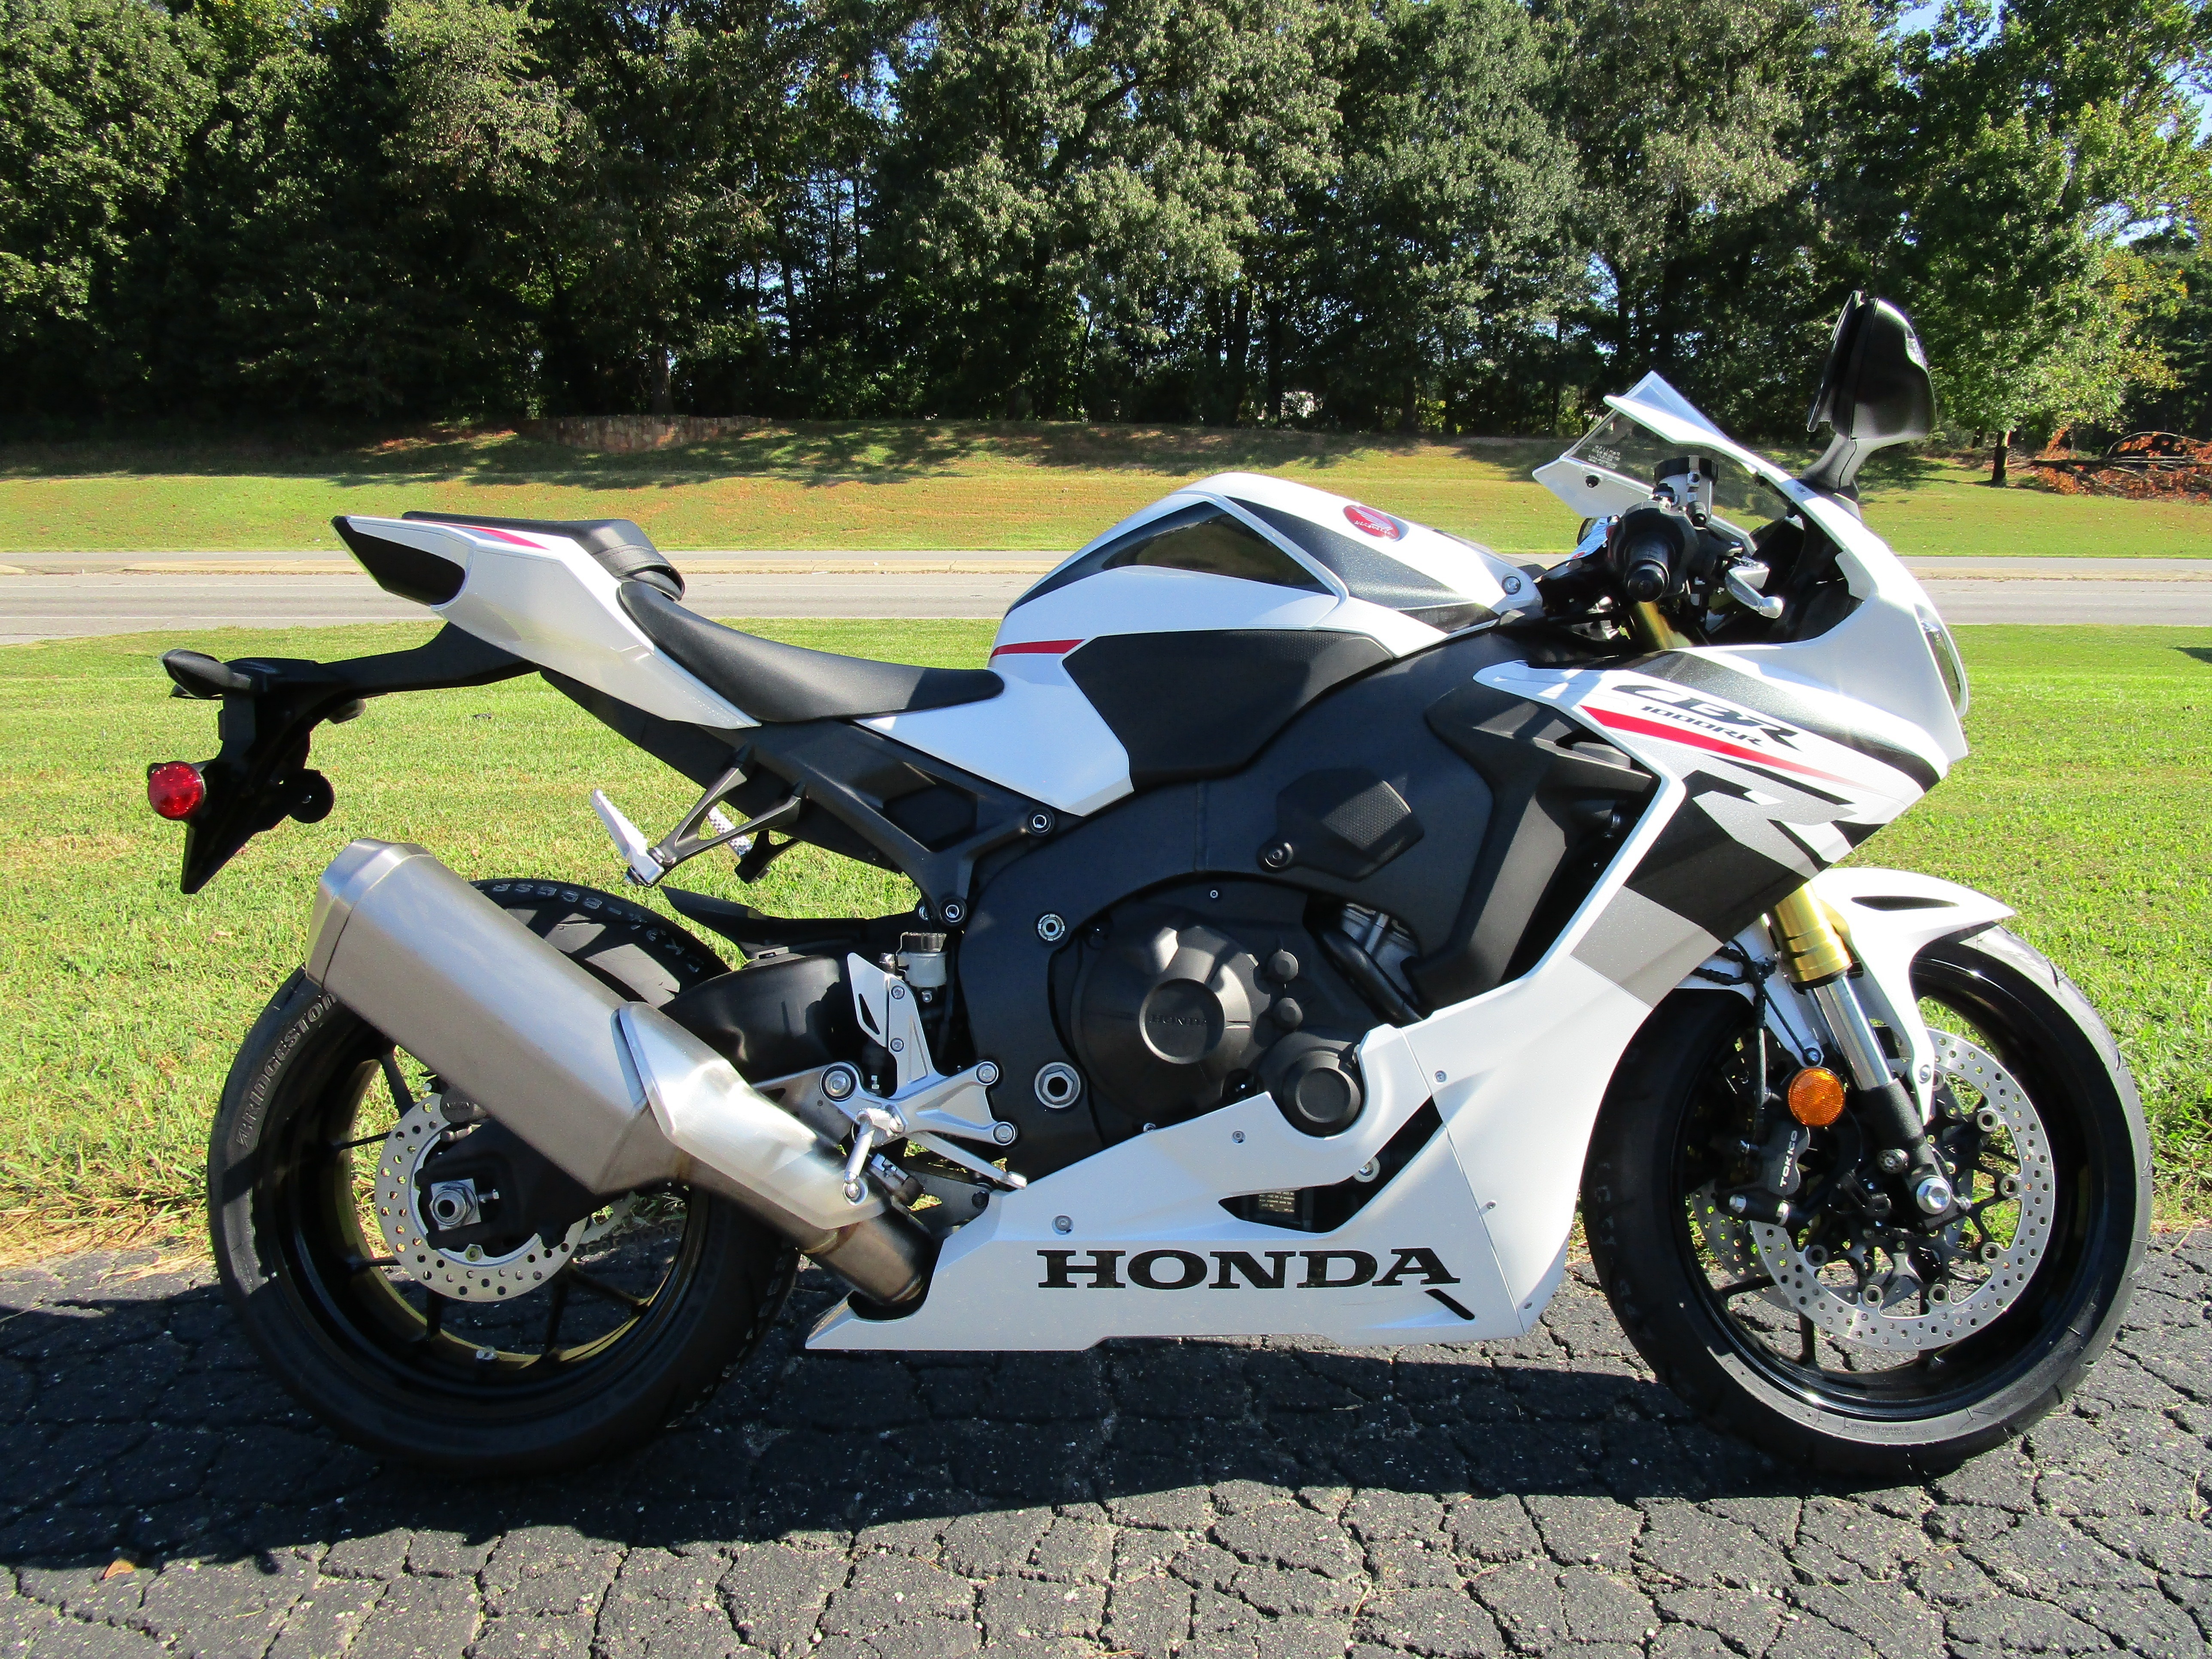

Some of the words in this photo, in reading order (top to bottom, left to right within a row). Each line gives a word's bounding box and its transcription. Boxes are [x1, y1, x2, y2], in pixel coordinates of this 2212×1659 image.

[1611, 685, 1803, 752] CBR
[1641, 705, 1763, 747] 1000RR
[1779, 1130, 1798, 1187] TOKICO
[1036, 1248, 1461, 1289] HONDA
